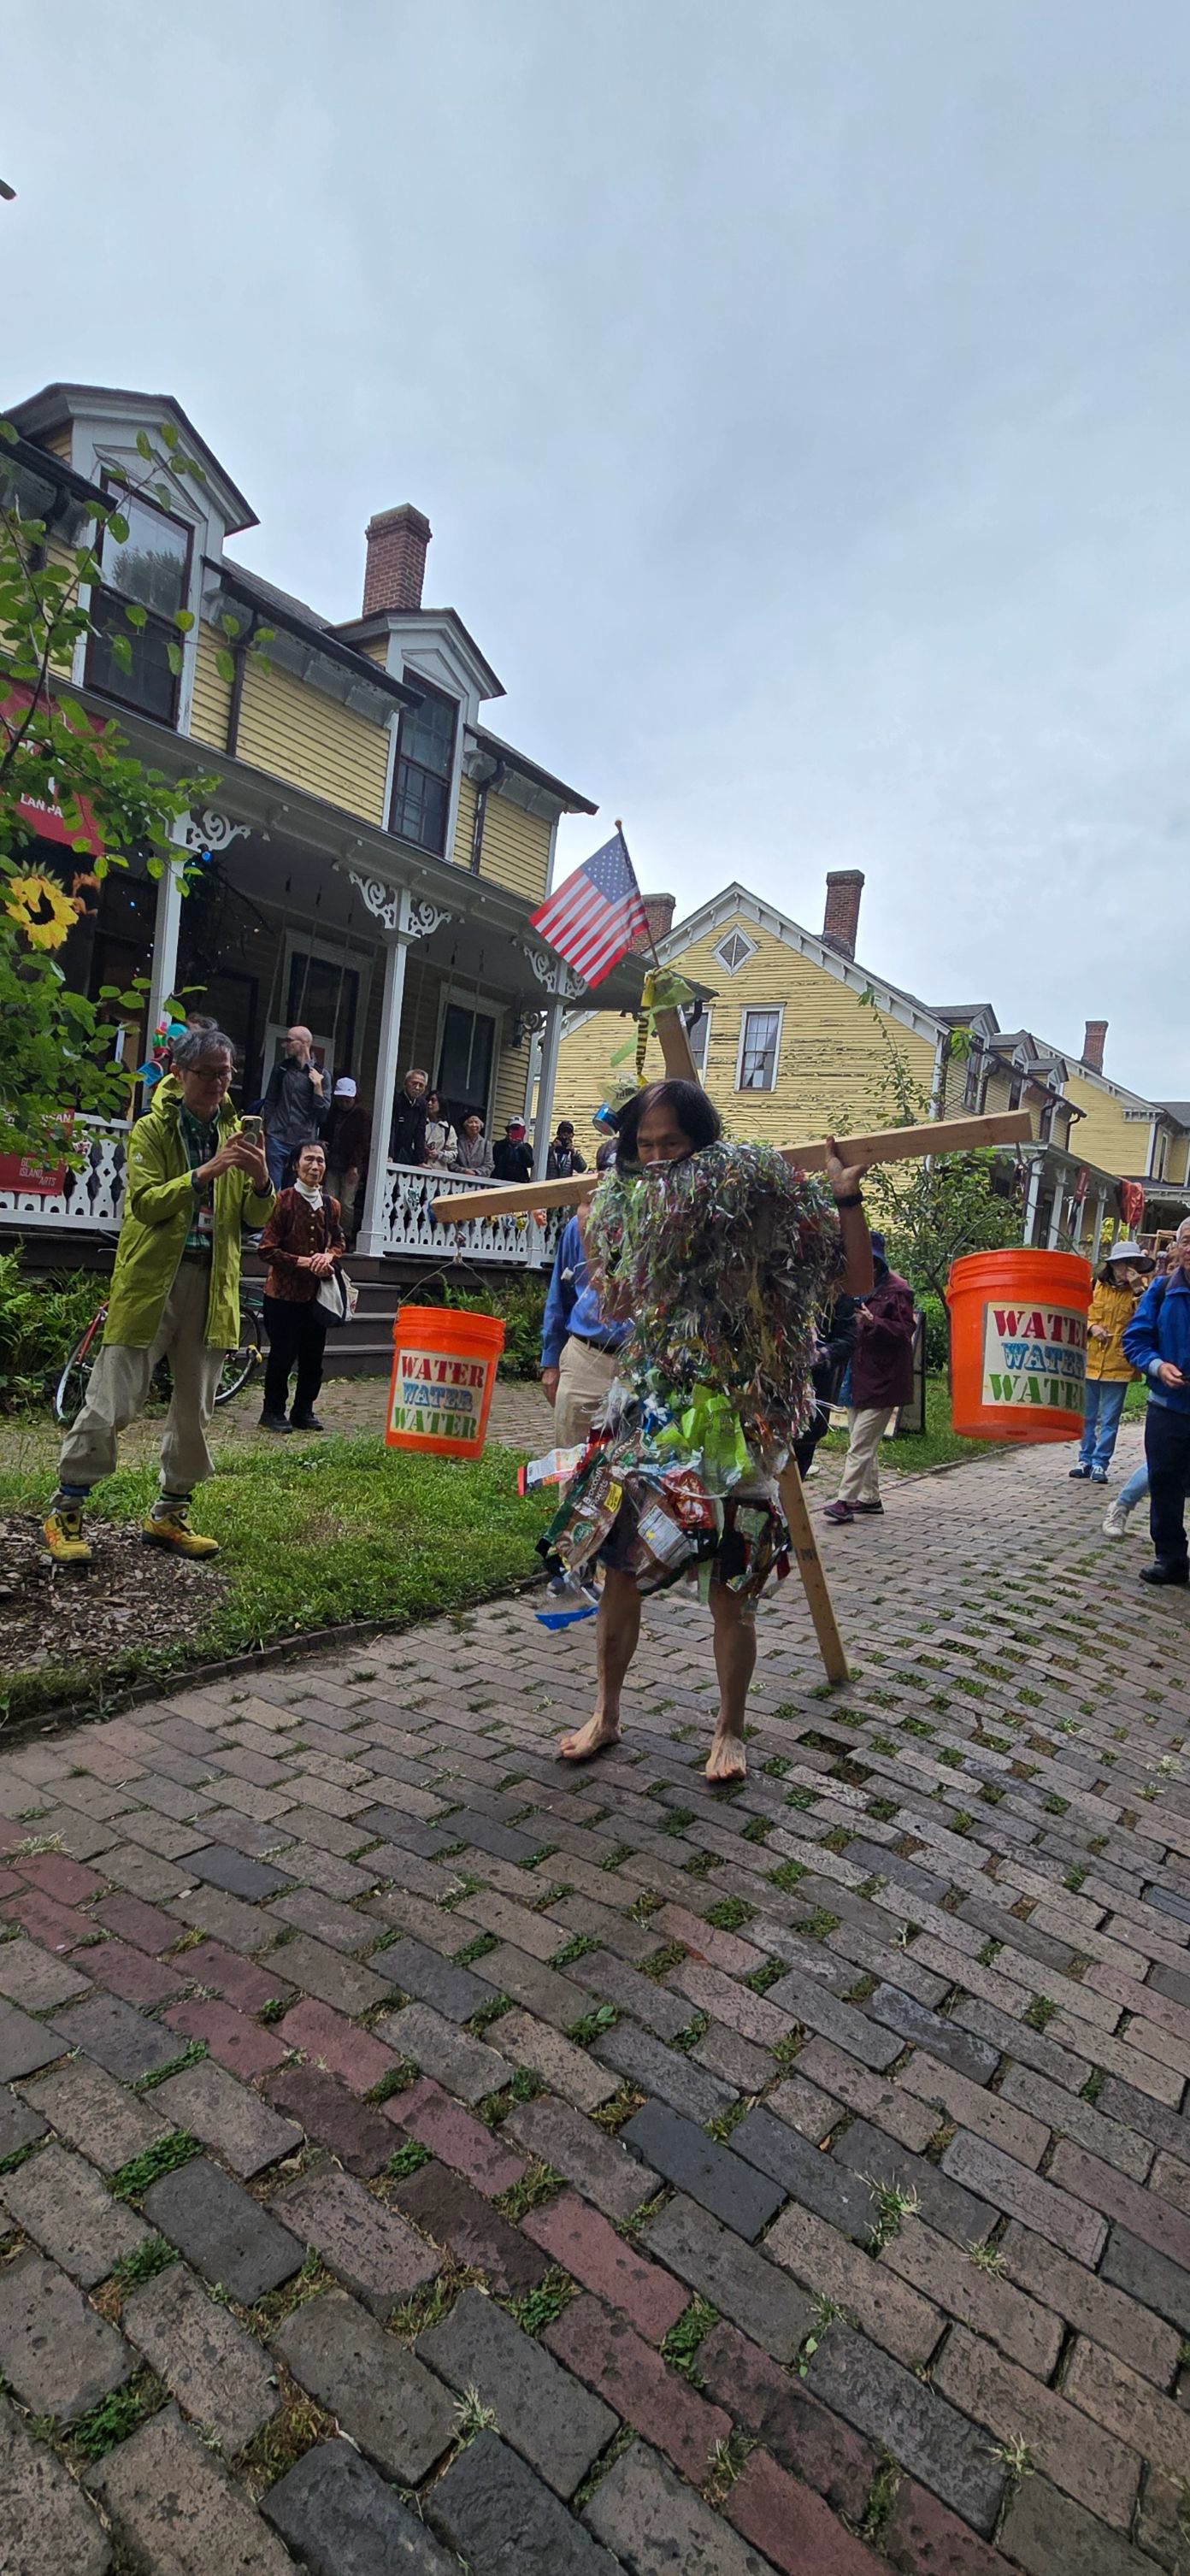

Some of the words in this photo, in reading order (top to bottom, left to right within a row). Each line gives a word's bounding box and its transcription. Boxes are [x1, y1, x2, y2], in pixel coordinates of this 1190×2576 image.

[20, 1167, 44, 1178] ISLAND
[38, 1176, 57, 1187] ARTS
[402, 1356, 484, 1388] WATER
[404, 1382, 473, 1412] WATER
[395, 1406, 477, 1440] WATER
